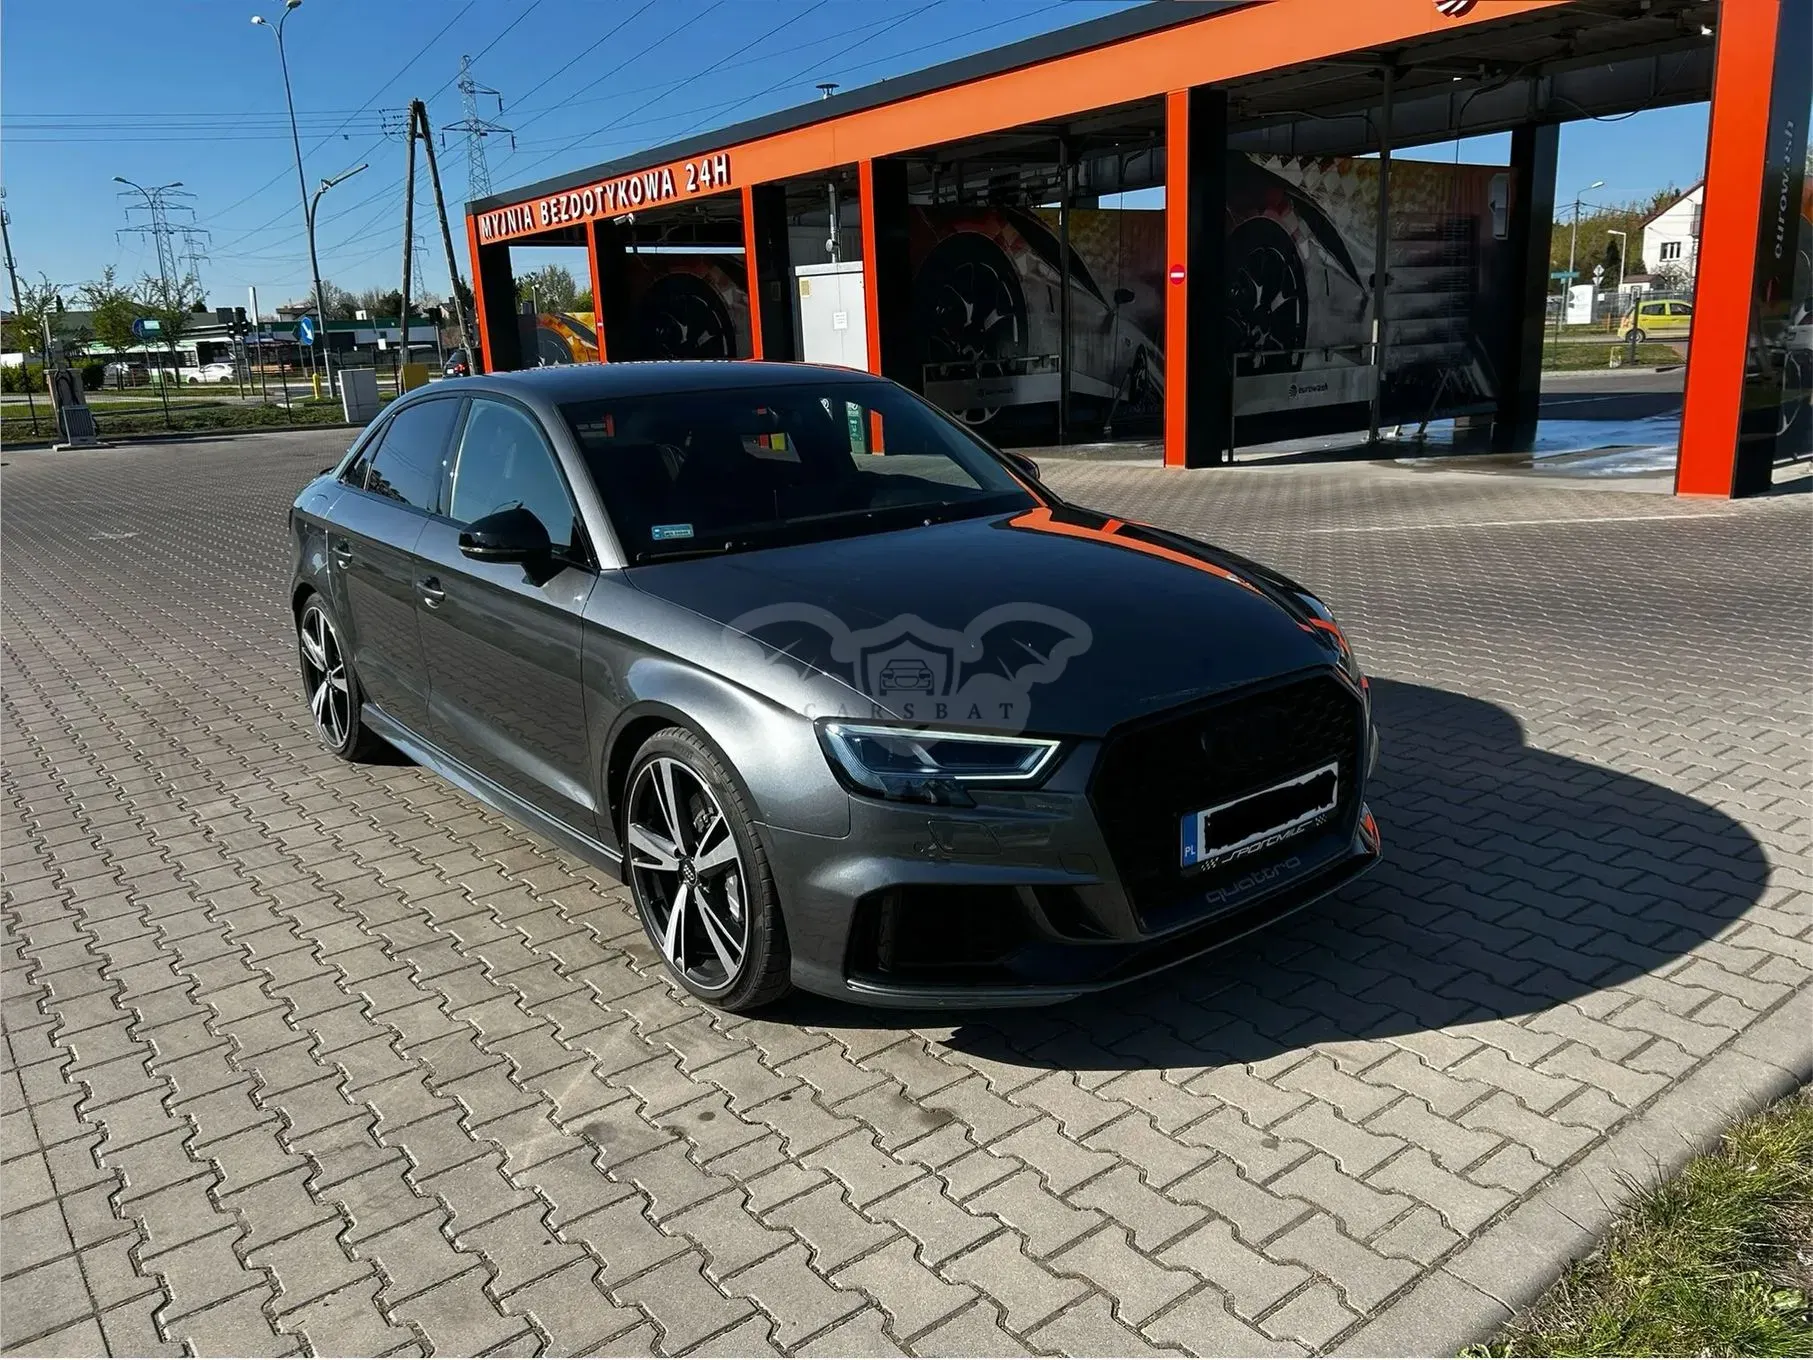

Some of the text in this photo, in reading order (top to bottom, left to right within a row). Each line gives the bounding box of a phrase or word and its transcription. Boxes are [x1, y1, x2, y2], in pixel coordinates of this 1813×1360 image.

[481, 153, 731, 239] MYJNIA BEZDOTYKOWA 24H
[1184, 845, 1196, 857] PL
[1205, 856, 1301, 903] quattro
